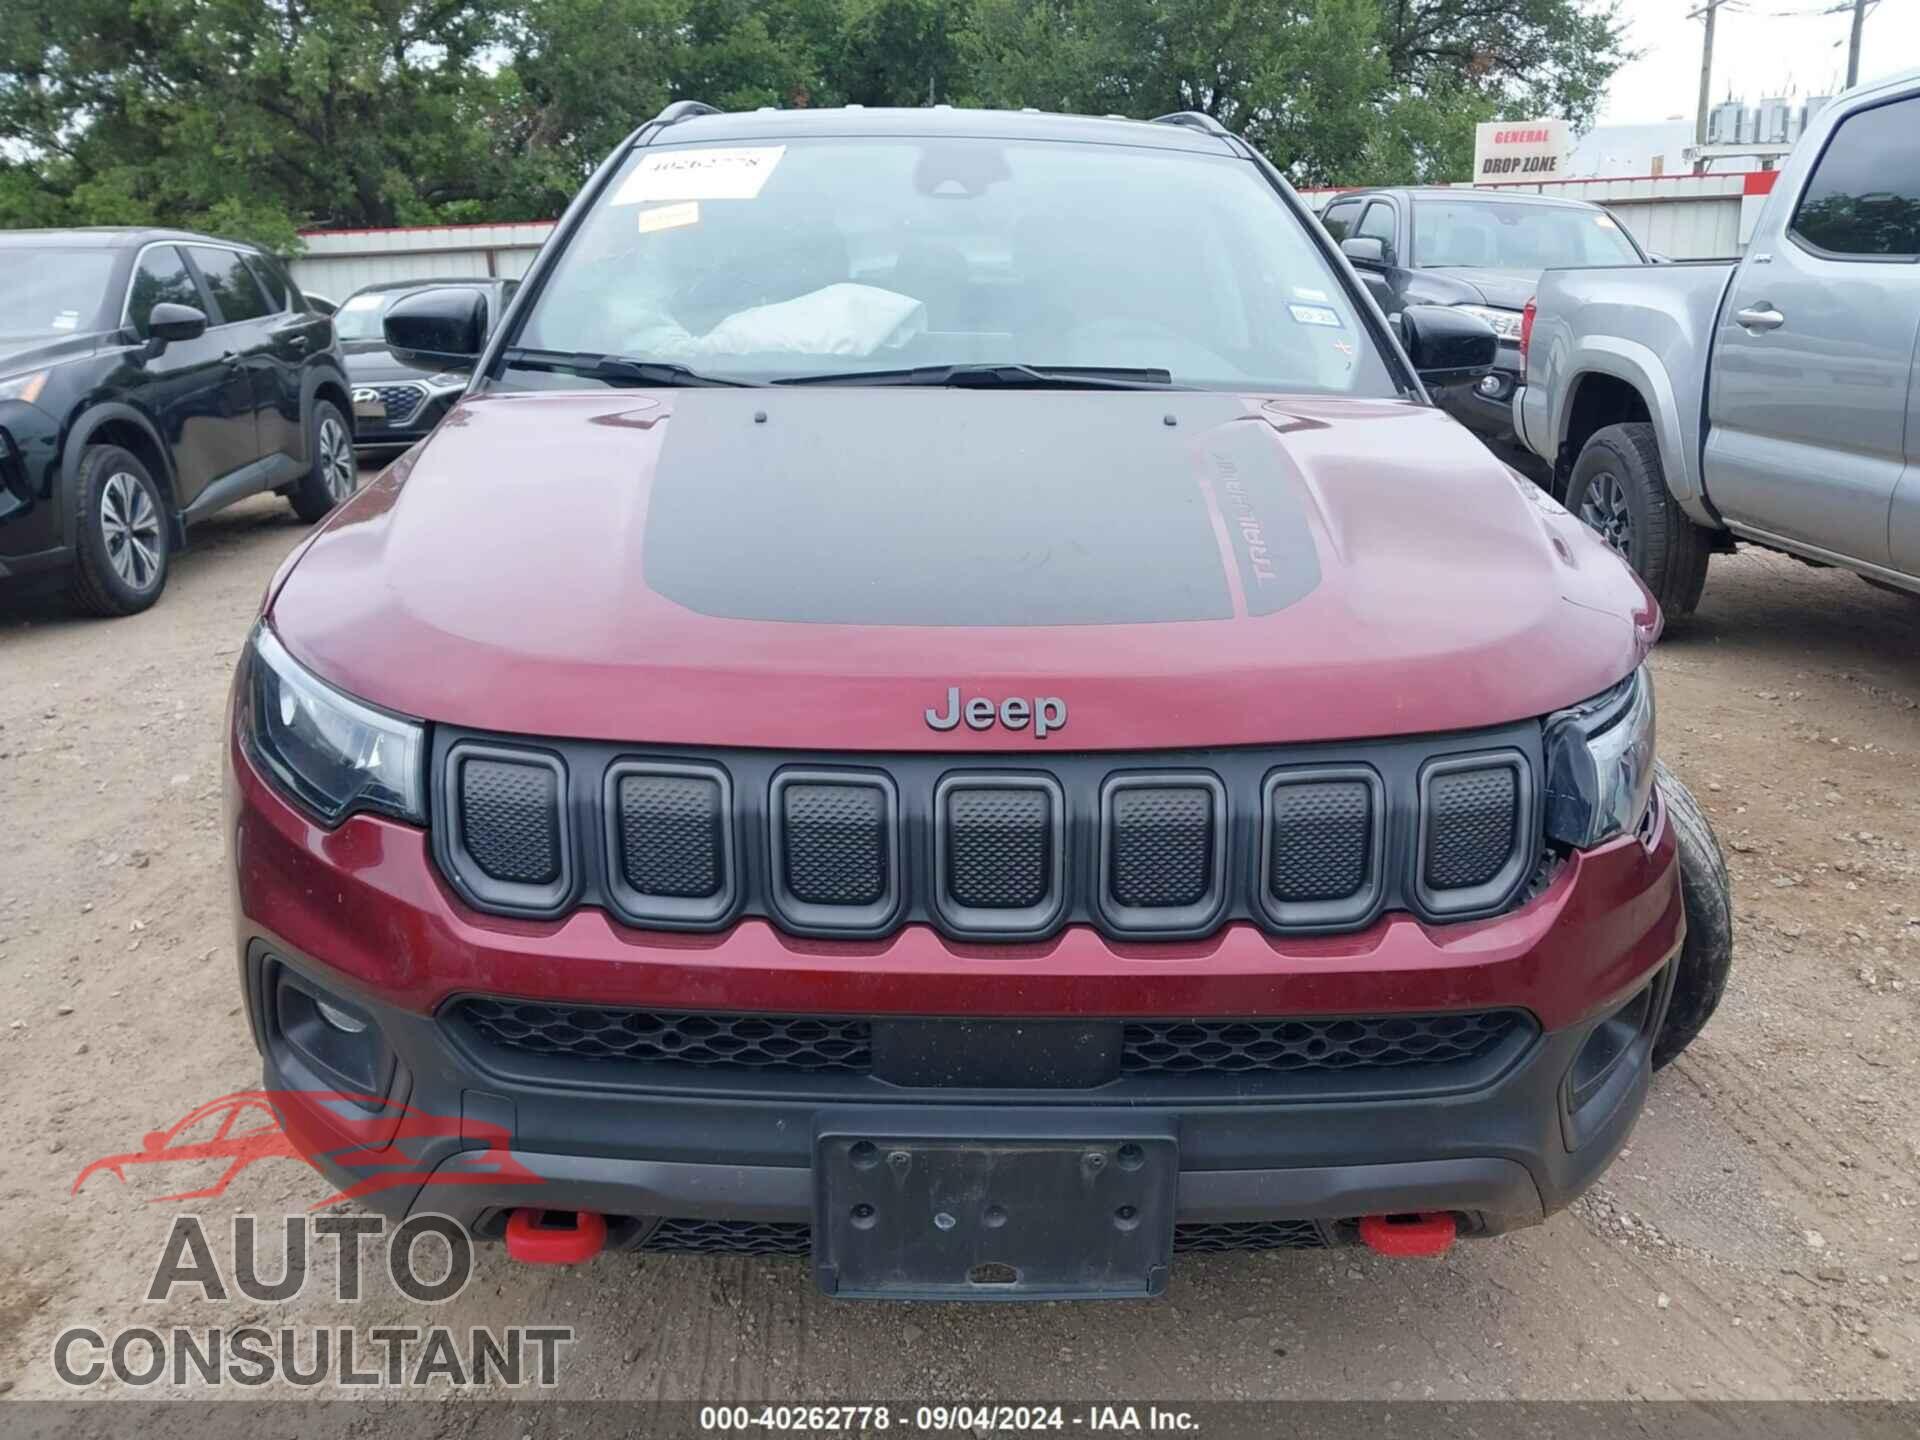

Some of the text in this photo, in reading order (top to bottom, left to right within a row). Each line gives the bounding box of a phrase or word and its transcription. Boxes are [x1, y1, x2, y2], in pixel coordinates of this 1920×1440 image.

[1494, 129, 1549, 144] GENERAL
[1482, 156, 1557, 174] DROP ZONE
[925, 687, 1067, 740] Jeep
